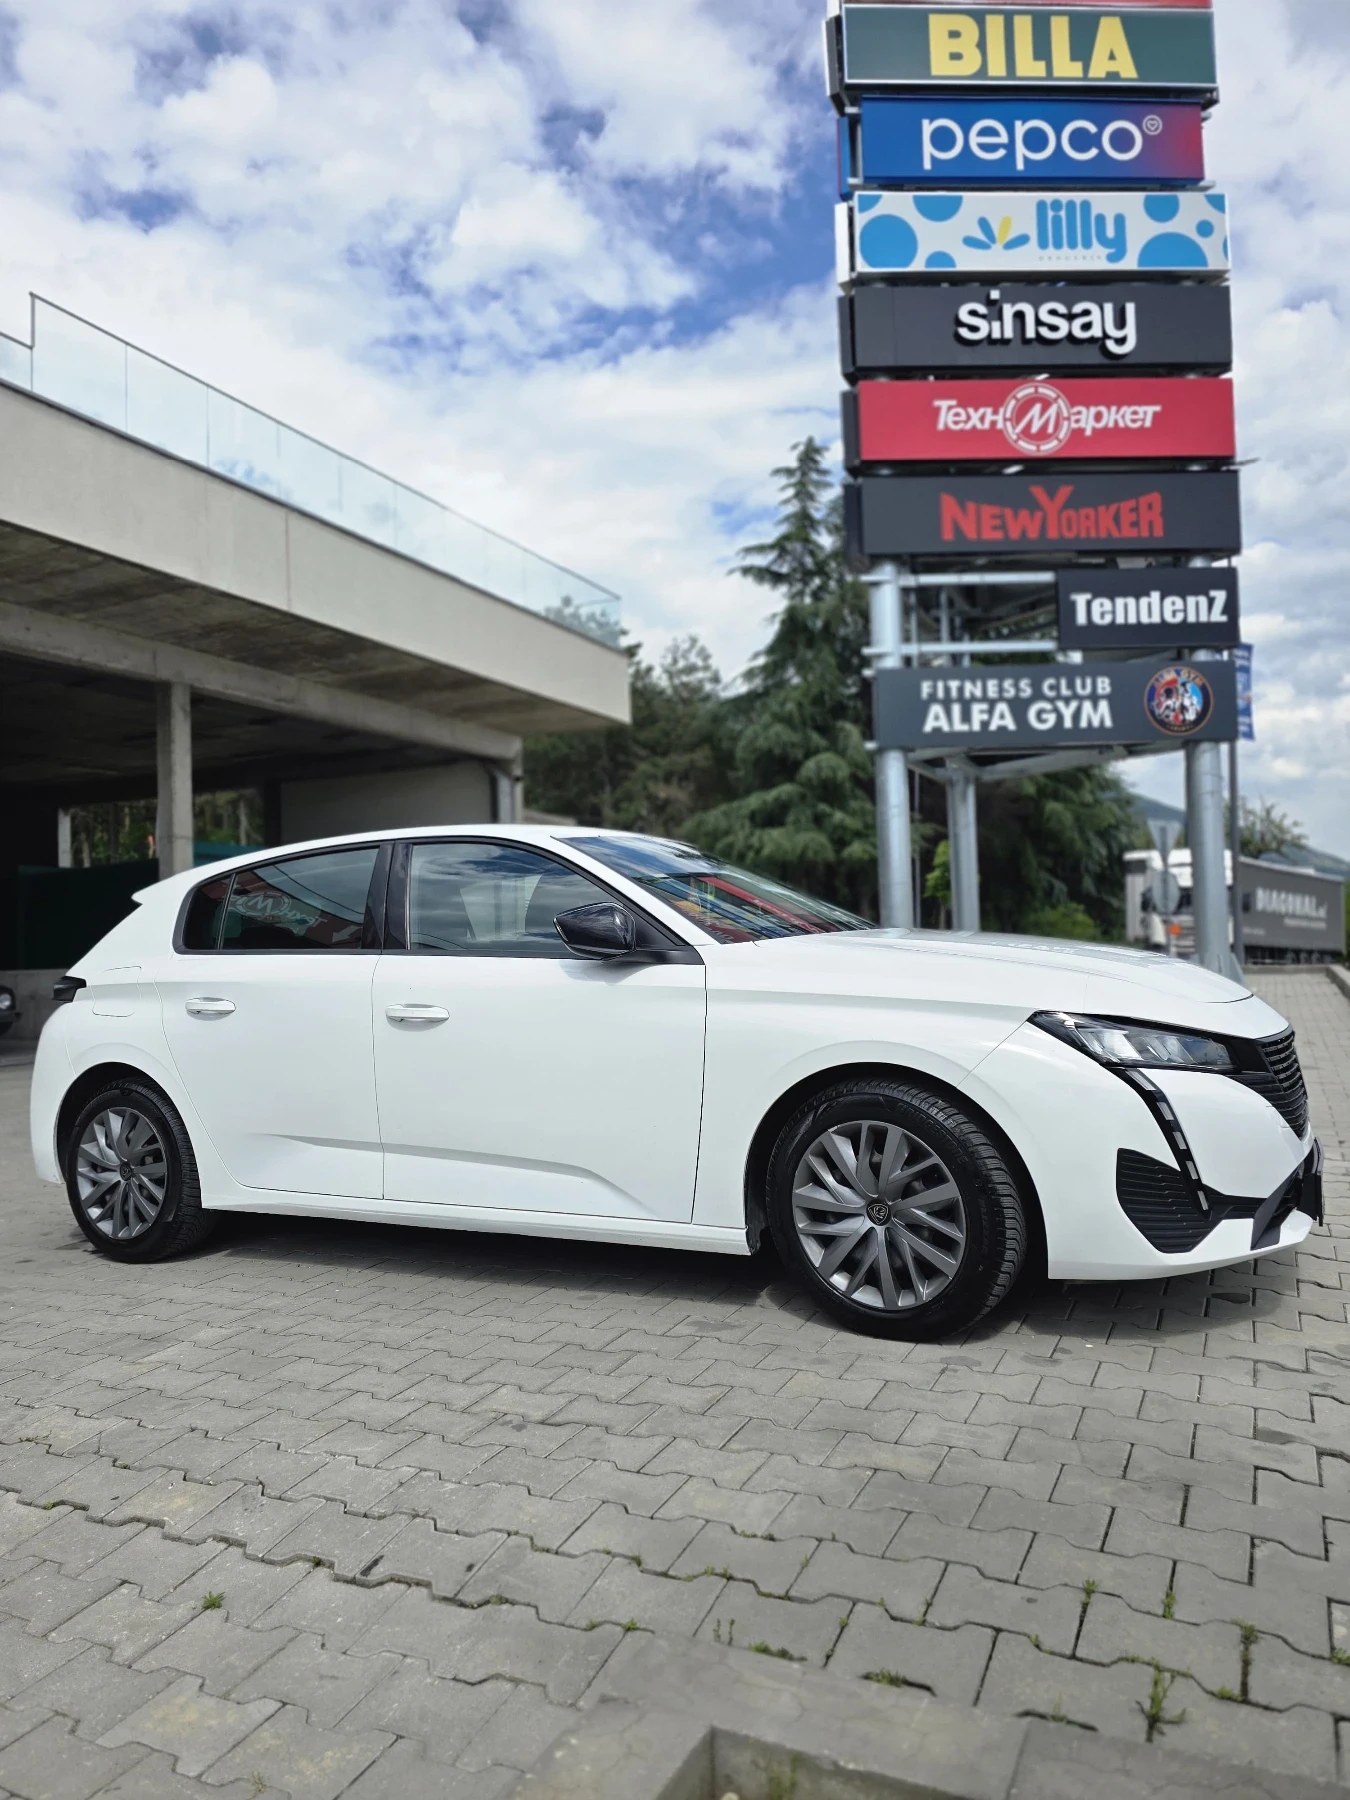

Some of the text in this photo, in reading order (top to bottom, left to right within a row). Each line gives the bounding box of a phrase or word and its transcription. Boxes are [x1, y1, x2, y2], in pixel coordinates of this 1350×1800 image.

[928, 13, 1138, 79] BILLA
[921, 117, 1142, 171] pepco
[1036, 198, 1127, 264] lilly
[956, 289, 1136, 356] sinsay
[1070, 589, 1229, 627] TendenZ
[920, 676, 1112, 701] FITNESS CLUB
[922, 701, 1114, 733] ALFA GYM
